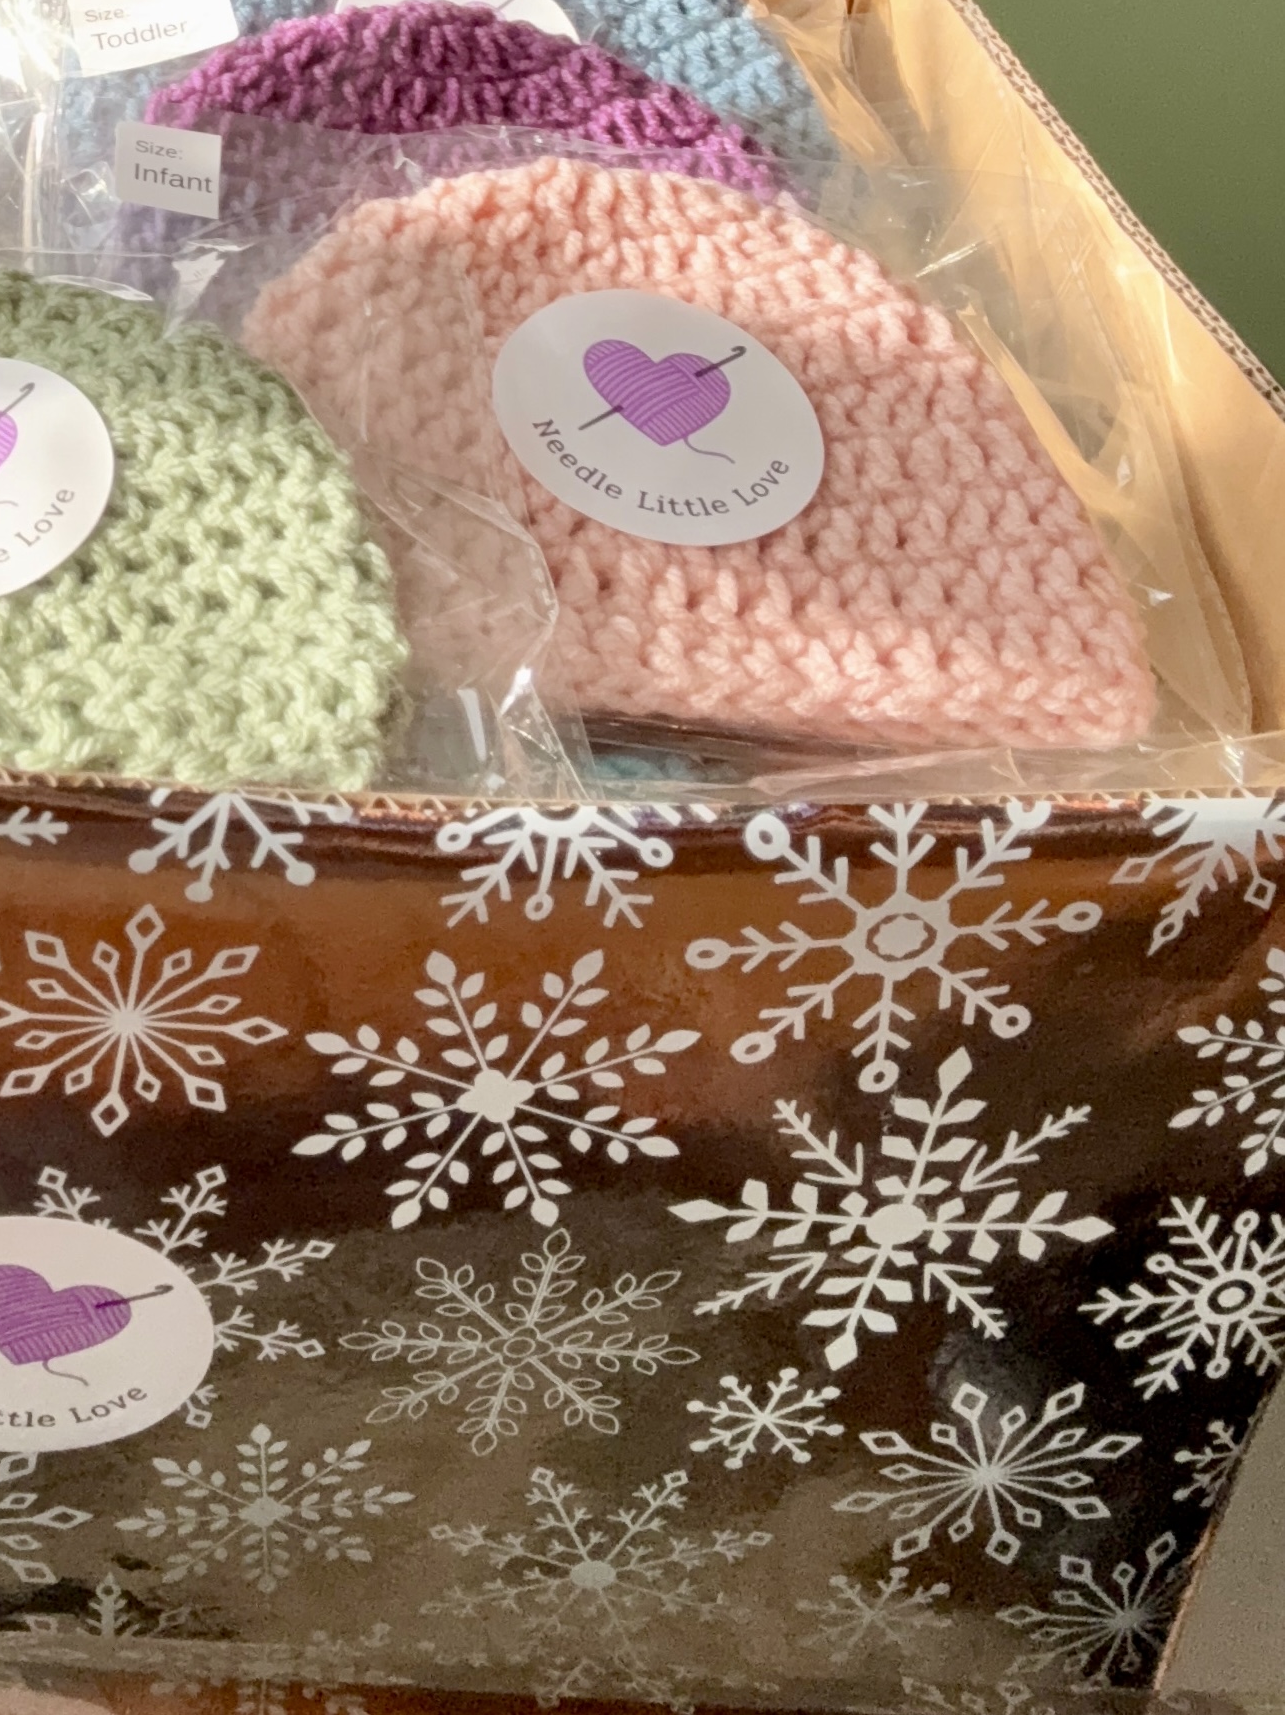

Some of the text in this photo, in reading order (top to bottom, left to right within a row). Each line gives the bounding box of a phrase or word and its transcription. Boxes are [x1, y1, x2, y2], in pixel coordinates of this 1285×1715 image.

[90, 21, 188, 51] Toddler
[135, 140, 183, 160] Size:
[134, 163, 213, 193] Infant
[531, 418, 790, 517] Needle Little Love
[14, 488, 76, 547] Love
[68, 1385, 148, 1424] Love
